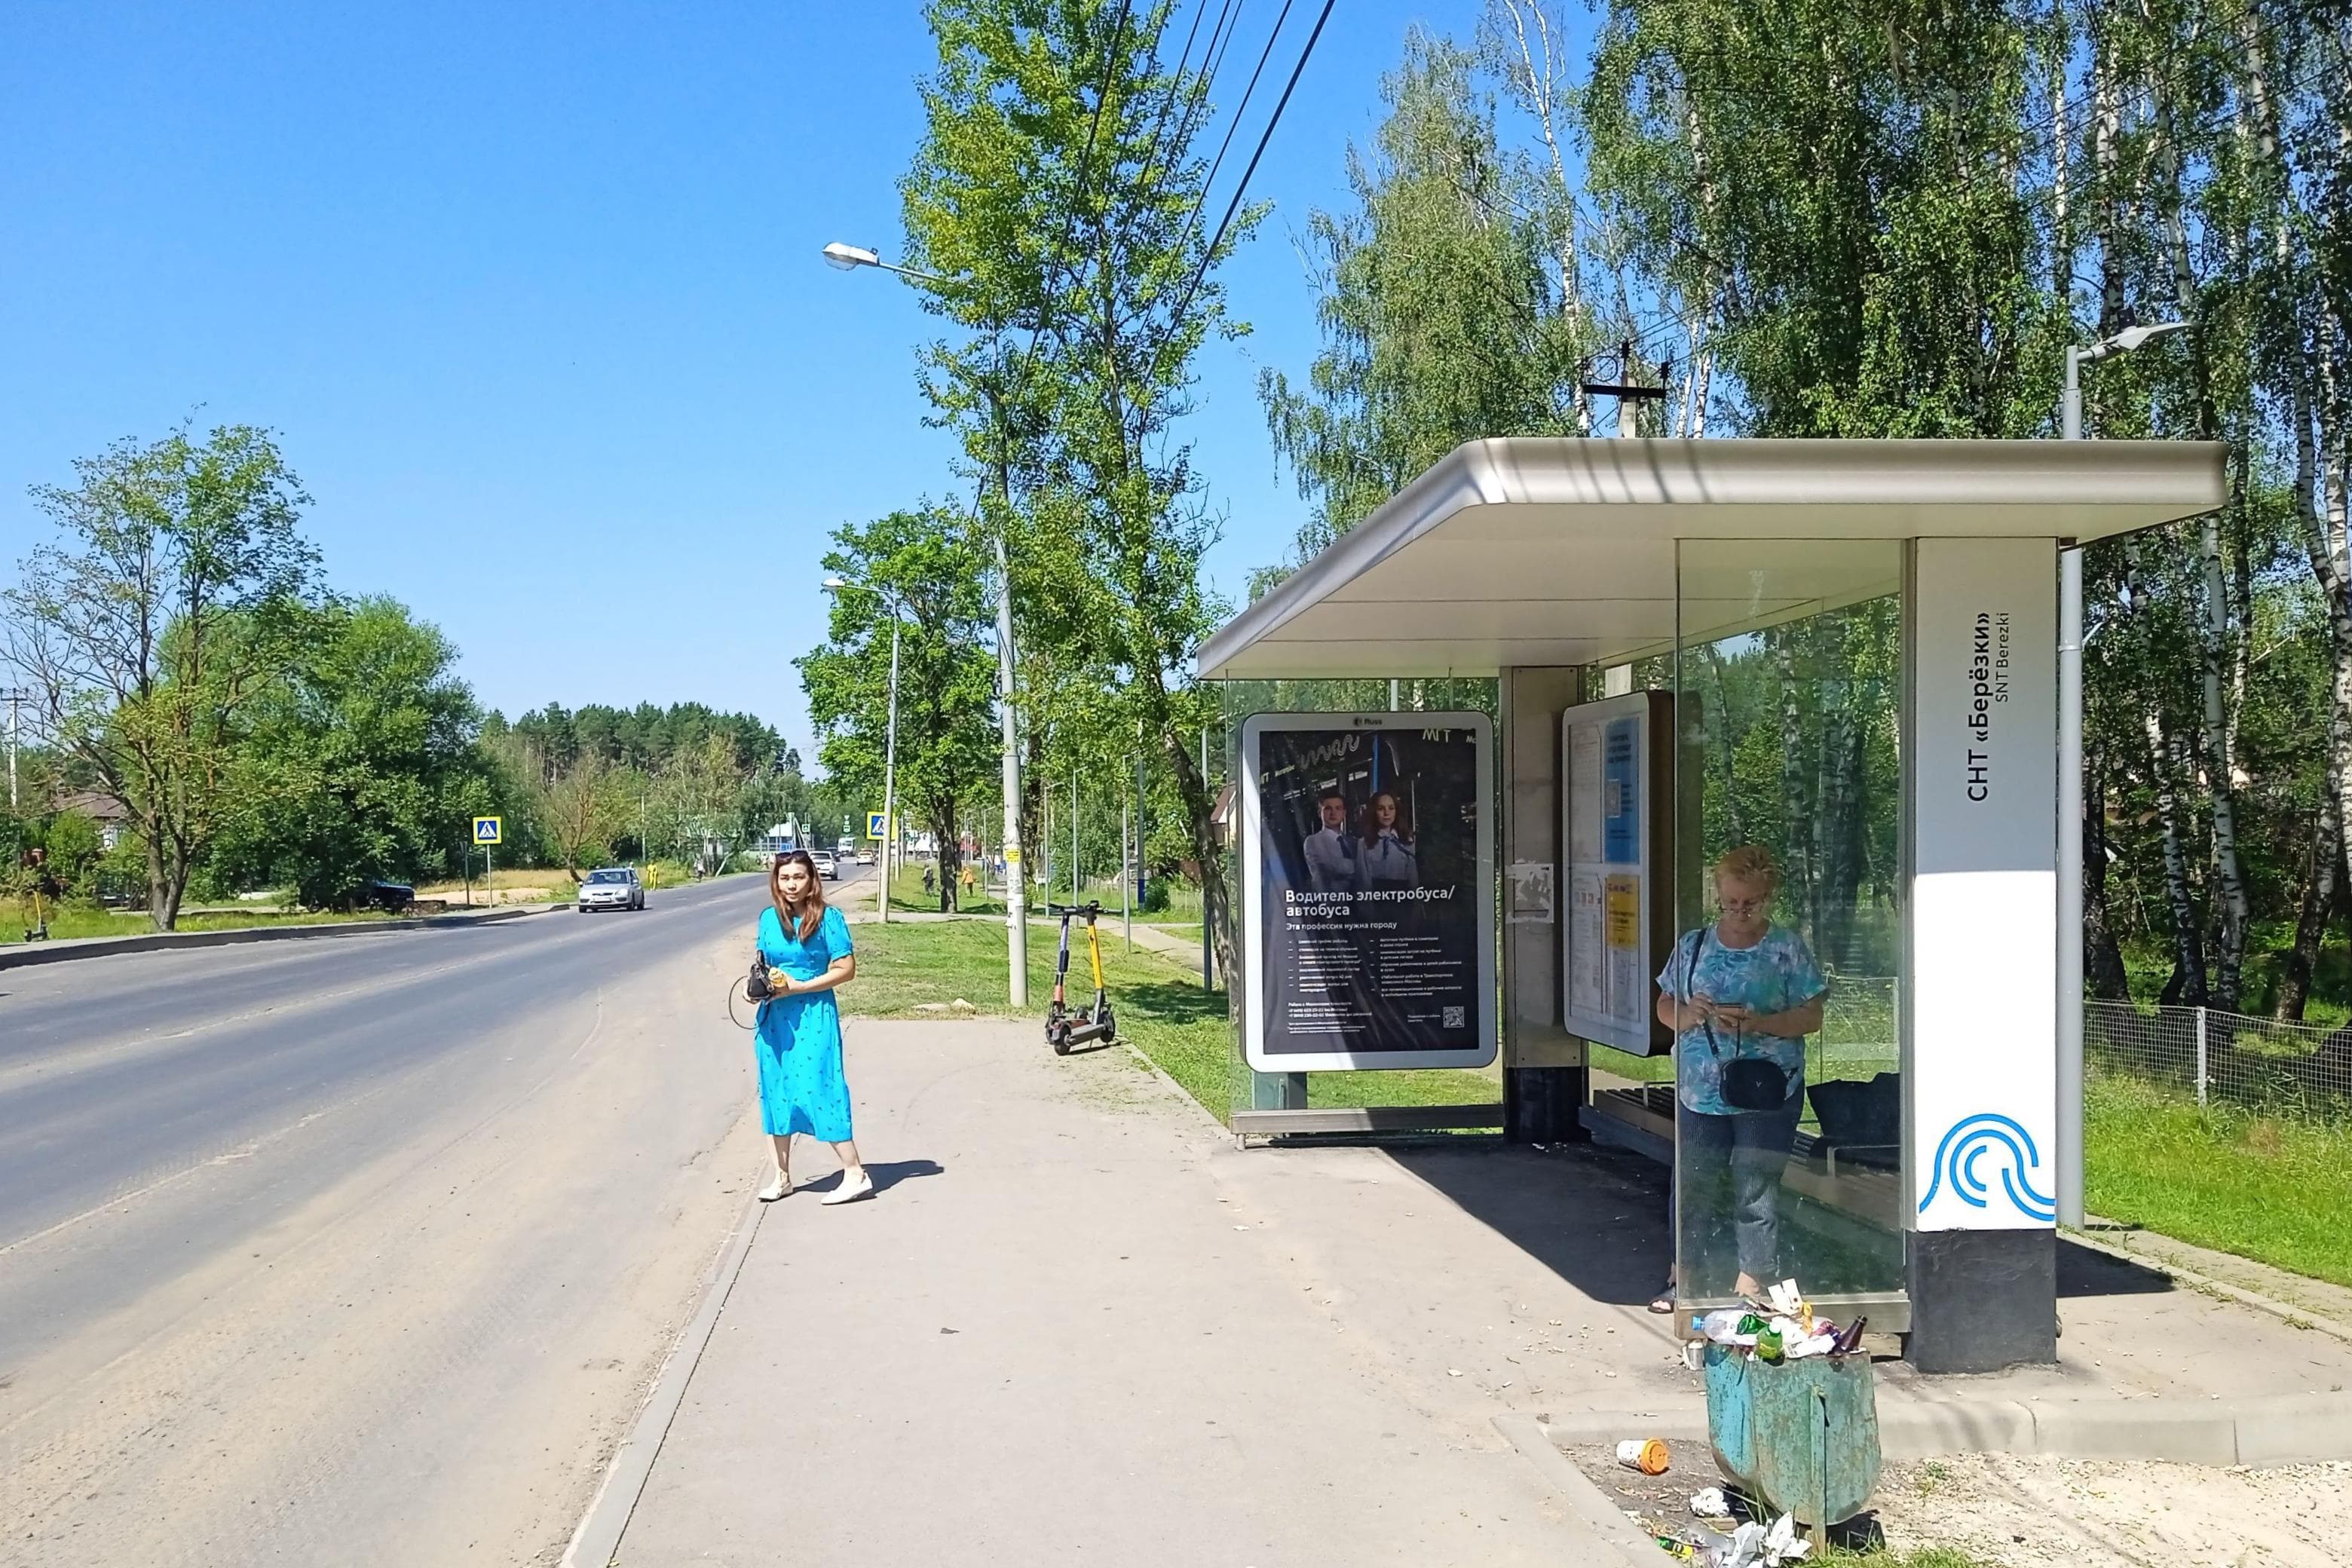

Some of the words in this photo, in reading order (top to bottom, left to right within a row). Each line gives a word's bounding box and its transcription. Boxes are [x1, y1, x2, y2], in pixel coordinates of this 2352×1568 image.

[1995, 612, 2009, 668] Berezki
[1968, 612, 1993, 743] «Берёзки»
[1995, 671, 2008, 703] SNT
[1968, 749, 1988, 802] СНТ
[1285, 890, 1353, 904] Водитель
[1357, 885, 1455, 903] электробуса/
[1286, 903, 1350, 919] автобуса
[1286, 923, 1300, 931] Эта
[1301, 922, 1343, 931] профессия
[1345, 923, 1368, 931] нужна
[1370, 922, 1397, 930] городу
